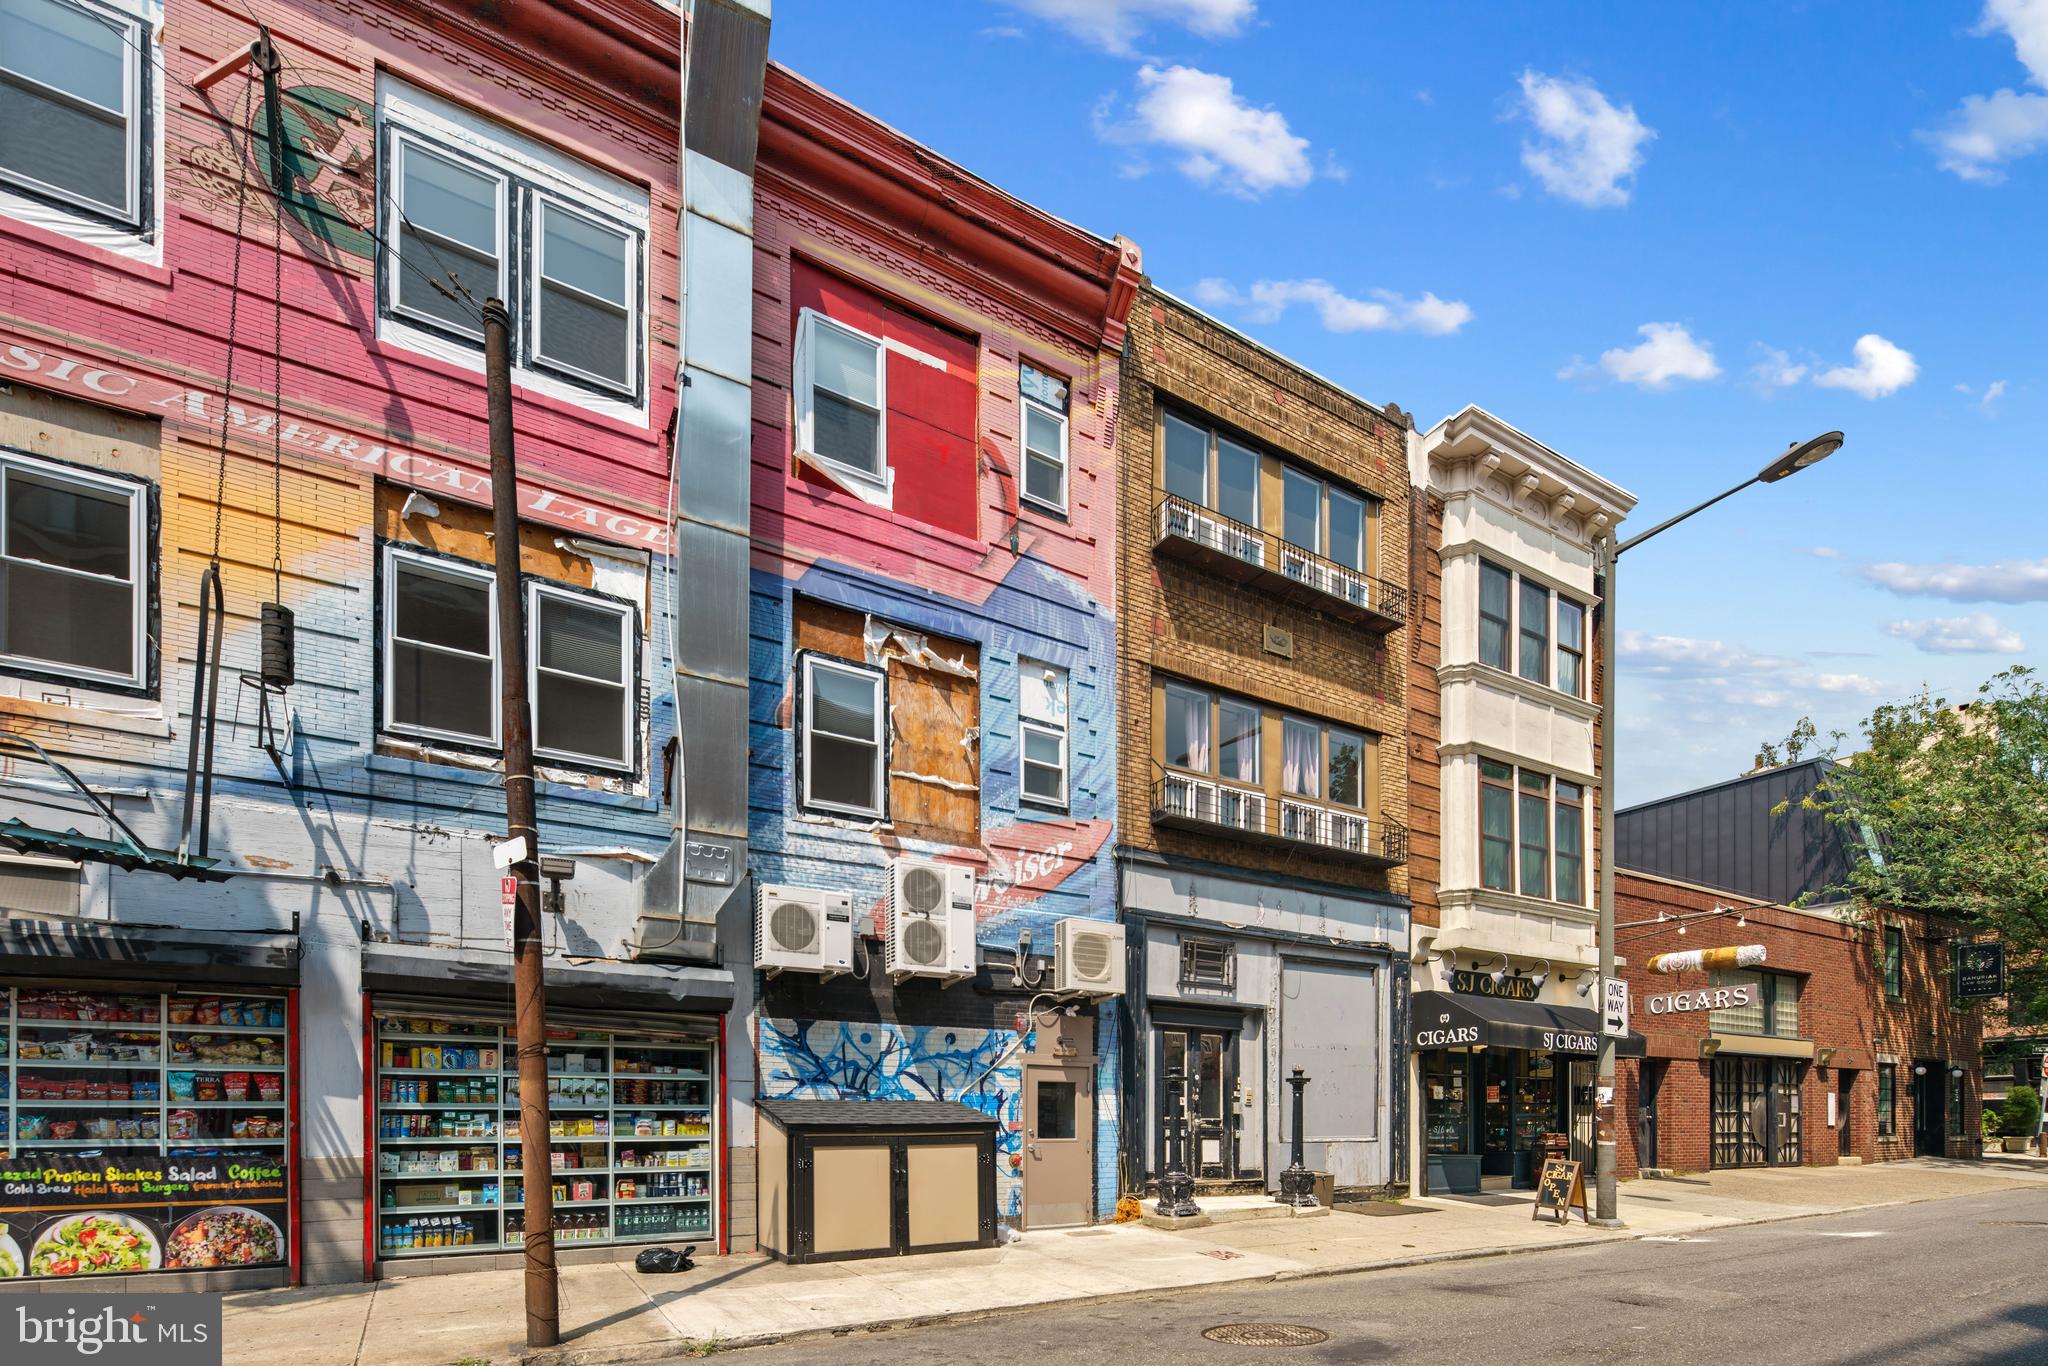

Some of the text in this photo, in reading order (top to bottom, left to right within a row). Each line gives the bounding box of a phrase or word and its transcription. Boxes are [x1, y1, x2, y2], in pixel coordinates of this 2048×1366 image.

[1457, 973, 1535, 999] SJ CIGARS
[1608, 983, 1624, 998] ONE
[1608, 999, 1624, 1013] WAY
[1650, 987, 1749, 1015] CIGARS
[1417, 1027, 1478, 1046] CIGARS
[1543, 1033, 1598, 1050] SJ CIGARS
[0, 1164, 281, 1184] ezed Protien Shakes Salad Coffee
[1546, 1171, 1573, 1180] CIGAR
[1555, 1164, 1566, 1172] SJ
[4, 1183, 34, 1194] Cold
[37, 1183, 71, 1194] Brew
[73, 1184, 108, 1197] Halal
[110, 1183, 139, 1194] Food
[142, 1182, 189, 1195] Burgers
[1543, 1179, 1566, 1206] OPEN
